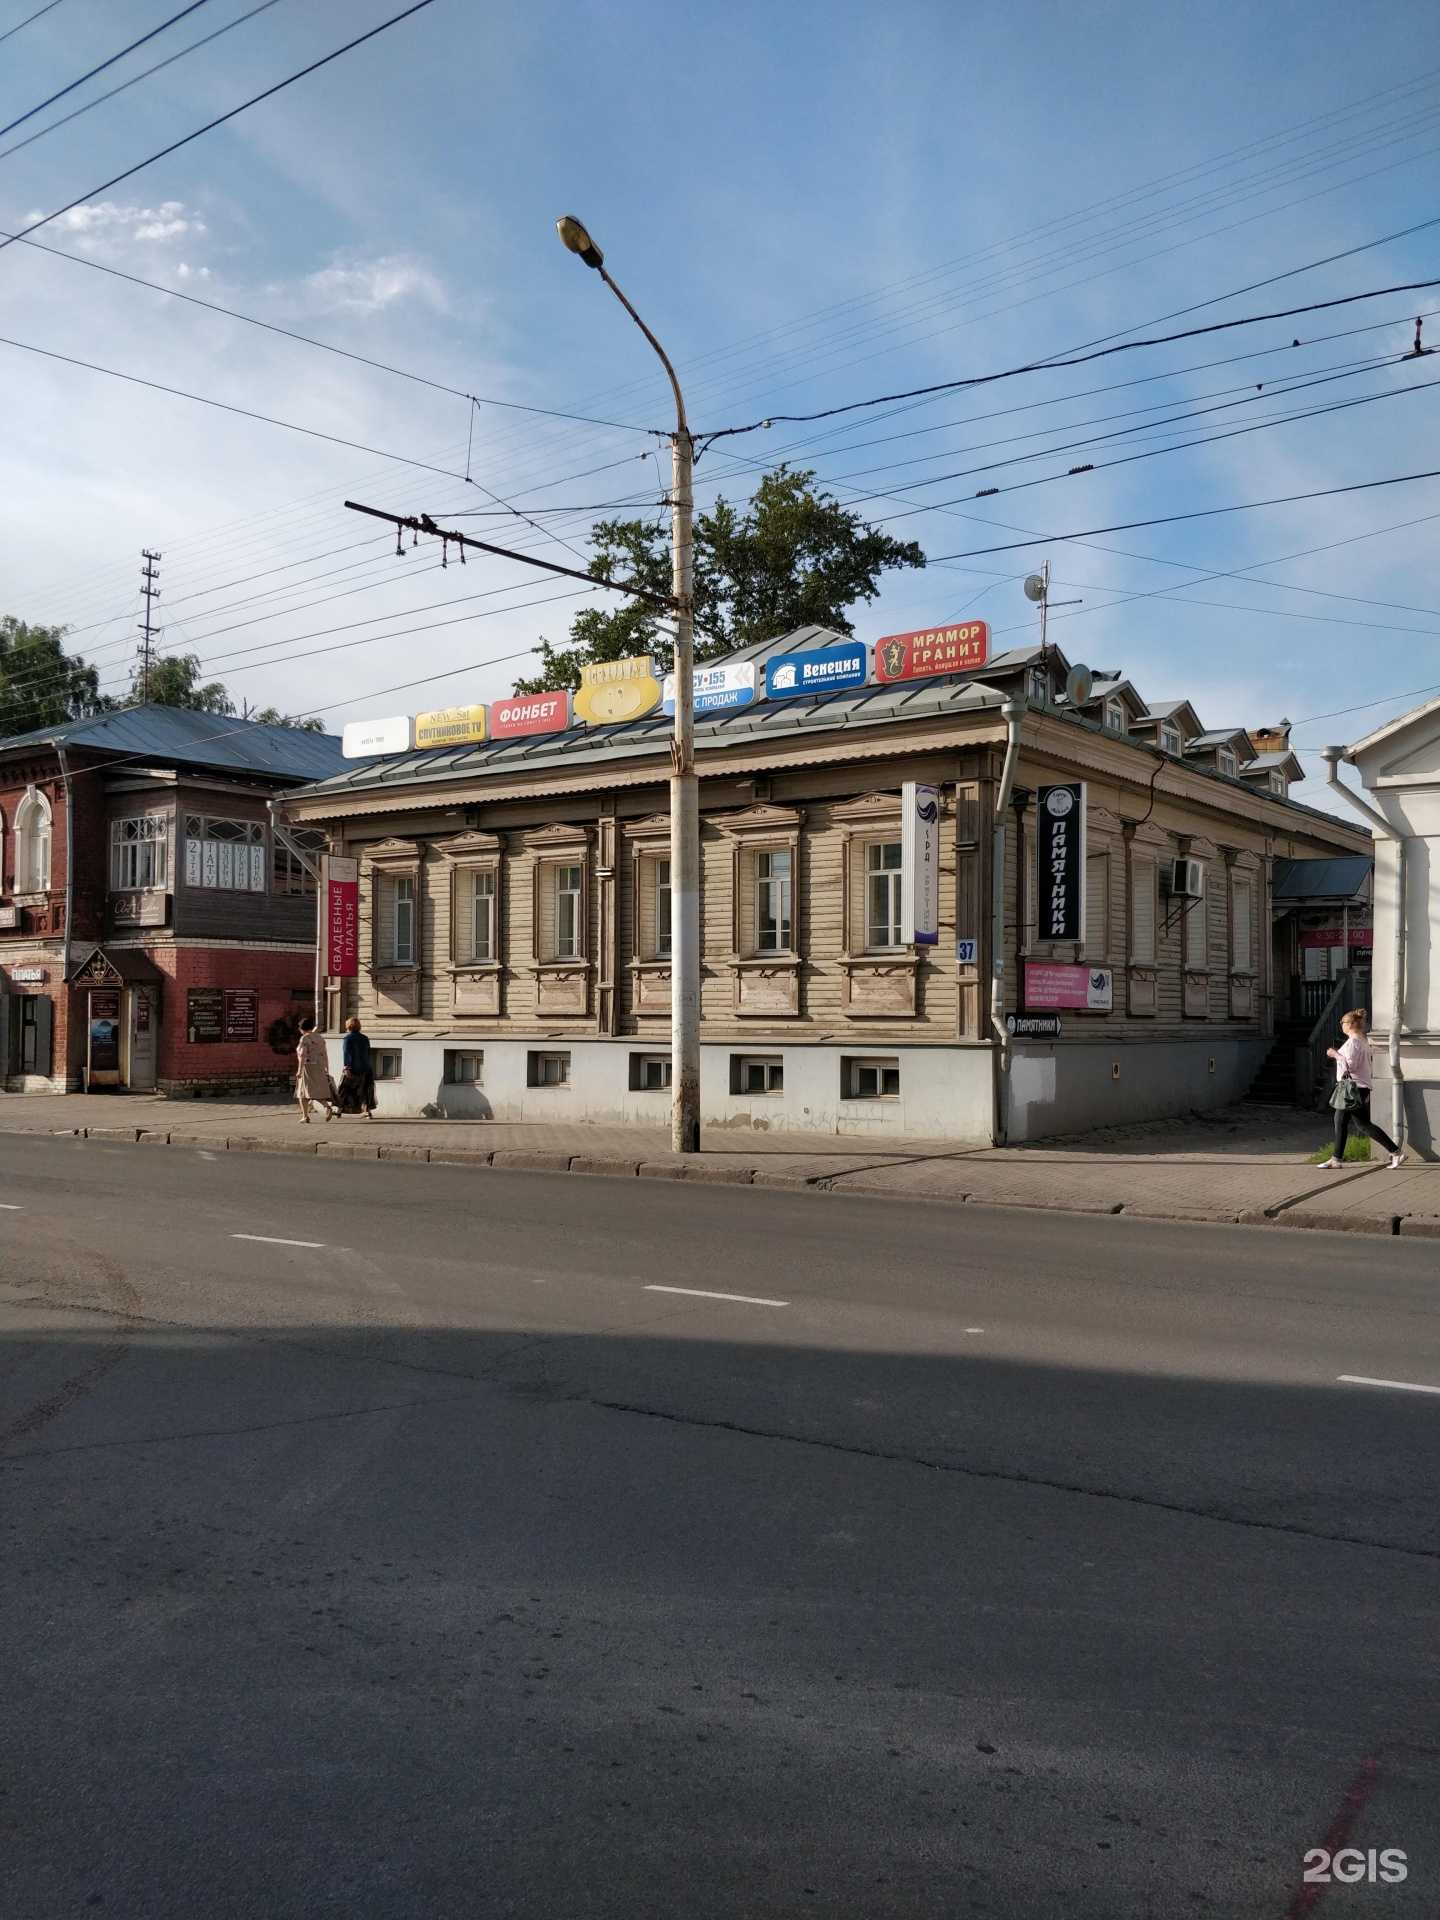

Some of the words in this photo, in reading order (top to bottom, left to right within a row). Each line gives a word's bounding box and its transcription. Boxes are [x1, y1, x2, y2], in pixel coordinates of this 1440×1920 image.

[912, 626, 981, 648] МРАМОР
[912, 642, 981, 664] ГРАНИТ
[803, 657, 860, 678] Венеция
[707, 692, 738, 707] ПРОДАЖ
[500, 701, 558, 722] ФОНБЕТ
[418, 722, 470, 739] СПУТНИКОВОЕ
[471, 720, 482, 734] TV
[1051, 821, 1066, 935] ПАМЯТНИКИ
[333, 887, 344, 972] СВАДЕБНЫЕ
[346, 904, 354, 956] ПЛАТЬЯ
[960, 942, 974, 960] 37
[1017, 1019, 1056, 1033] ПАМЯТНИКИ
